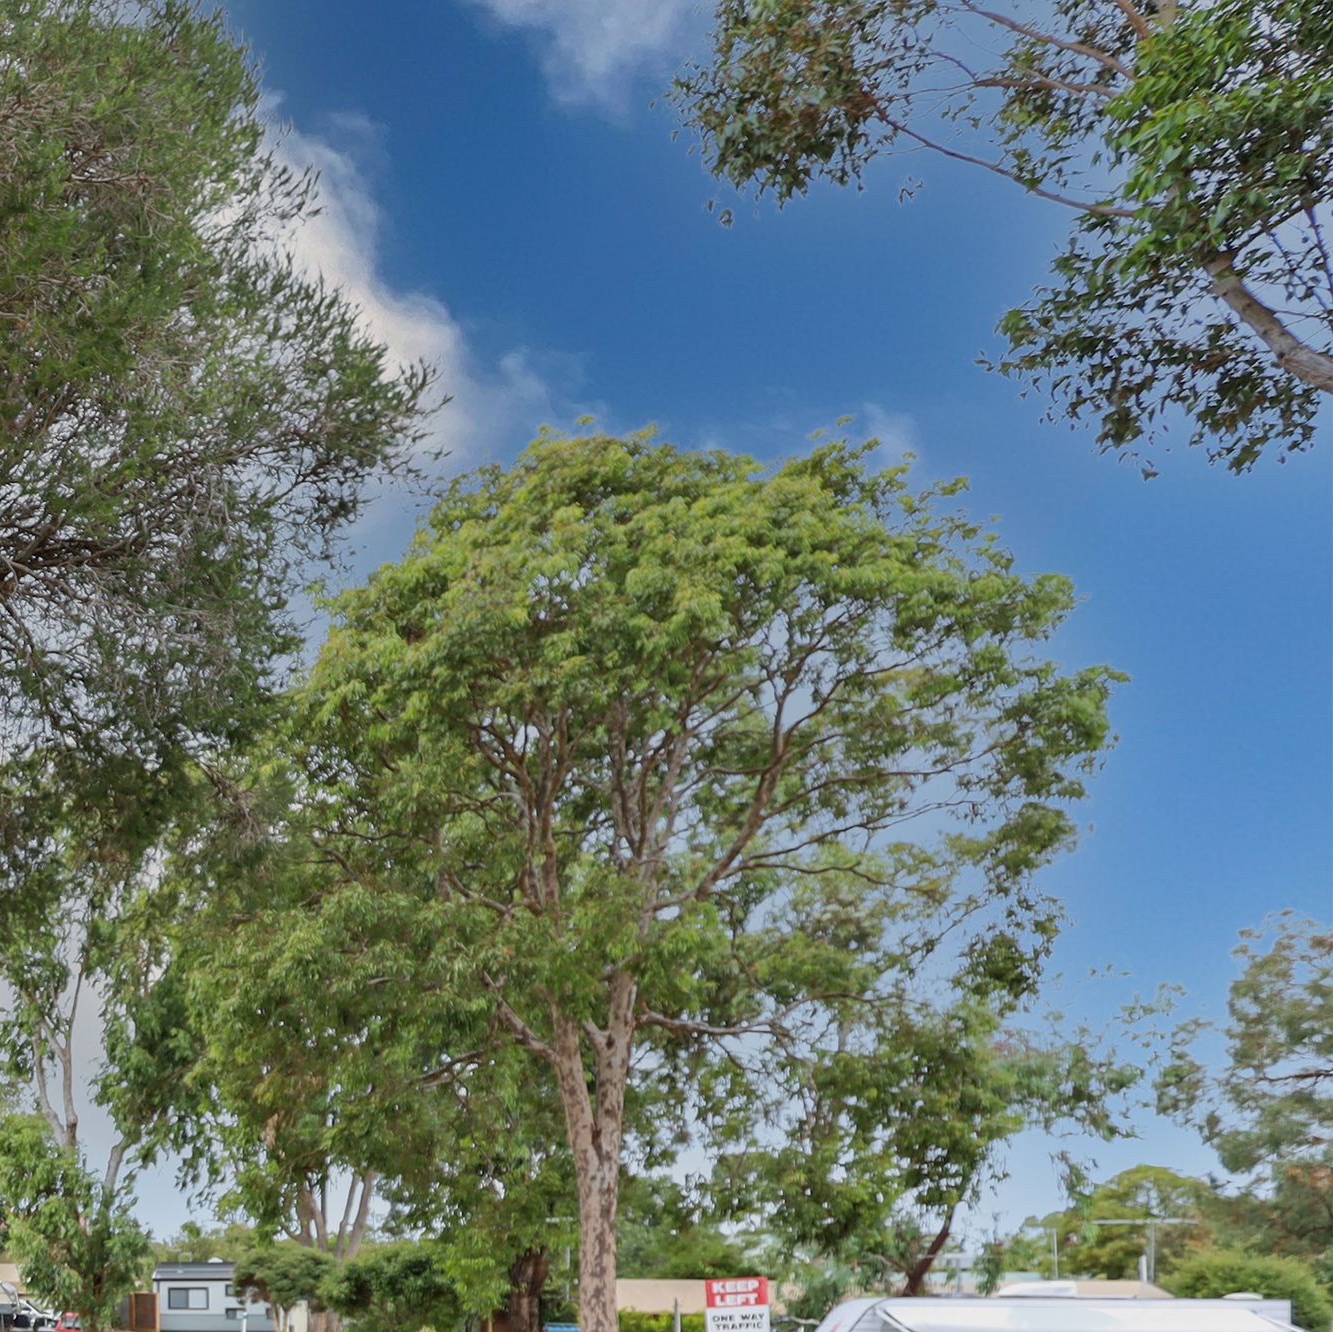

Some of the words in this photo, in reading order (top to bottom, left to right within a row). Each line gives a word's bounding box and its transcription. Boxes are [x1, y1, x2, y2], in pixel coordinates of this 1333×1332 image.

[711, 1280, 760, 1294] KEEP
[715, 1293, 759, 1307] LEFT
[712, 1314, 735, 1322] ONE
[741, 1313, 765, 1321] WAY
[715, 1321, 763, 1331] TRAFFIC
